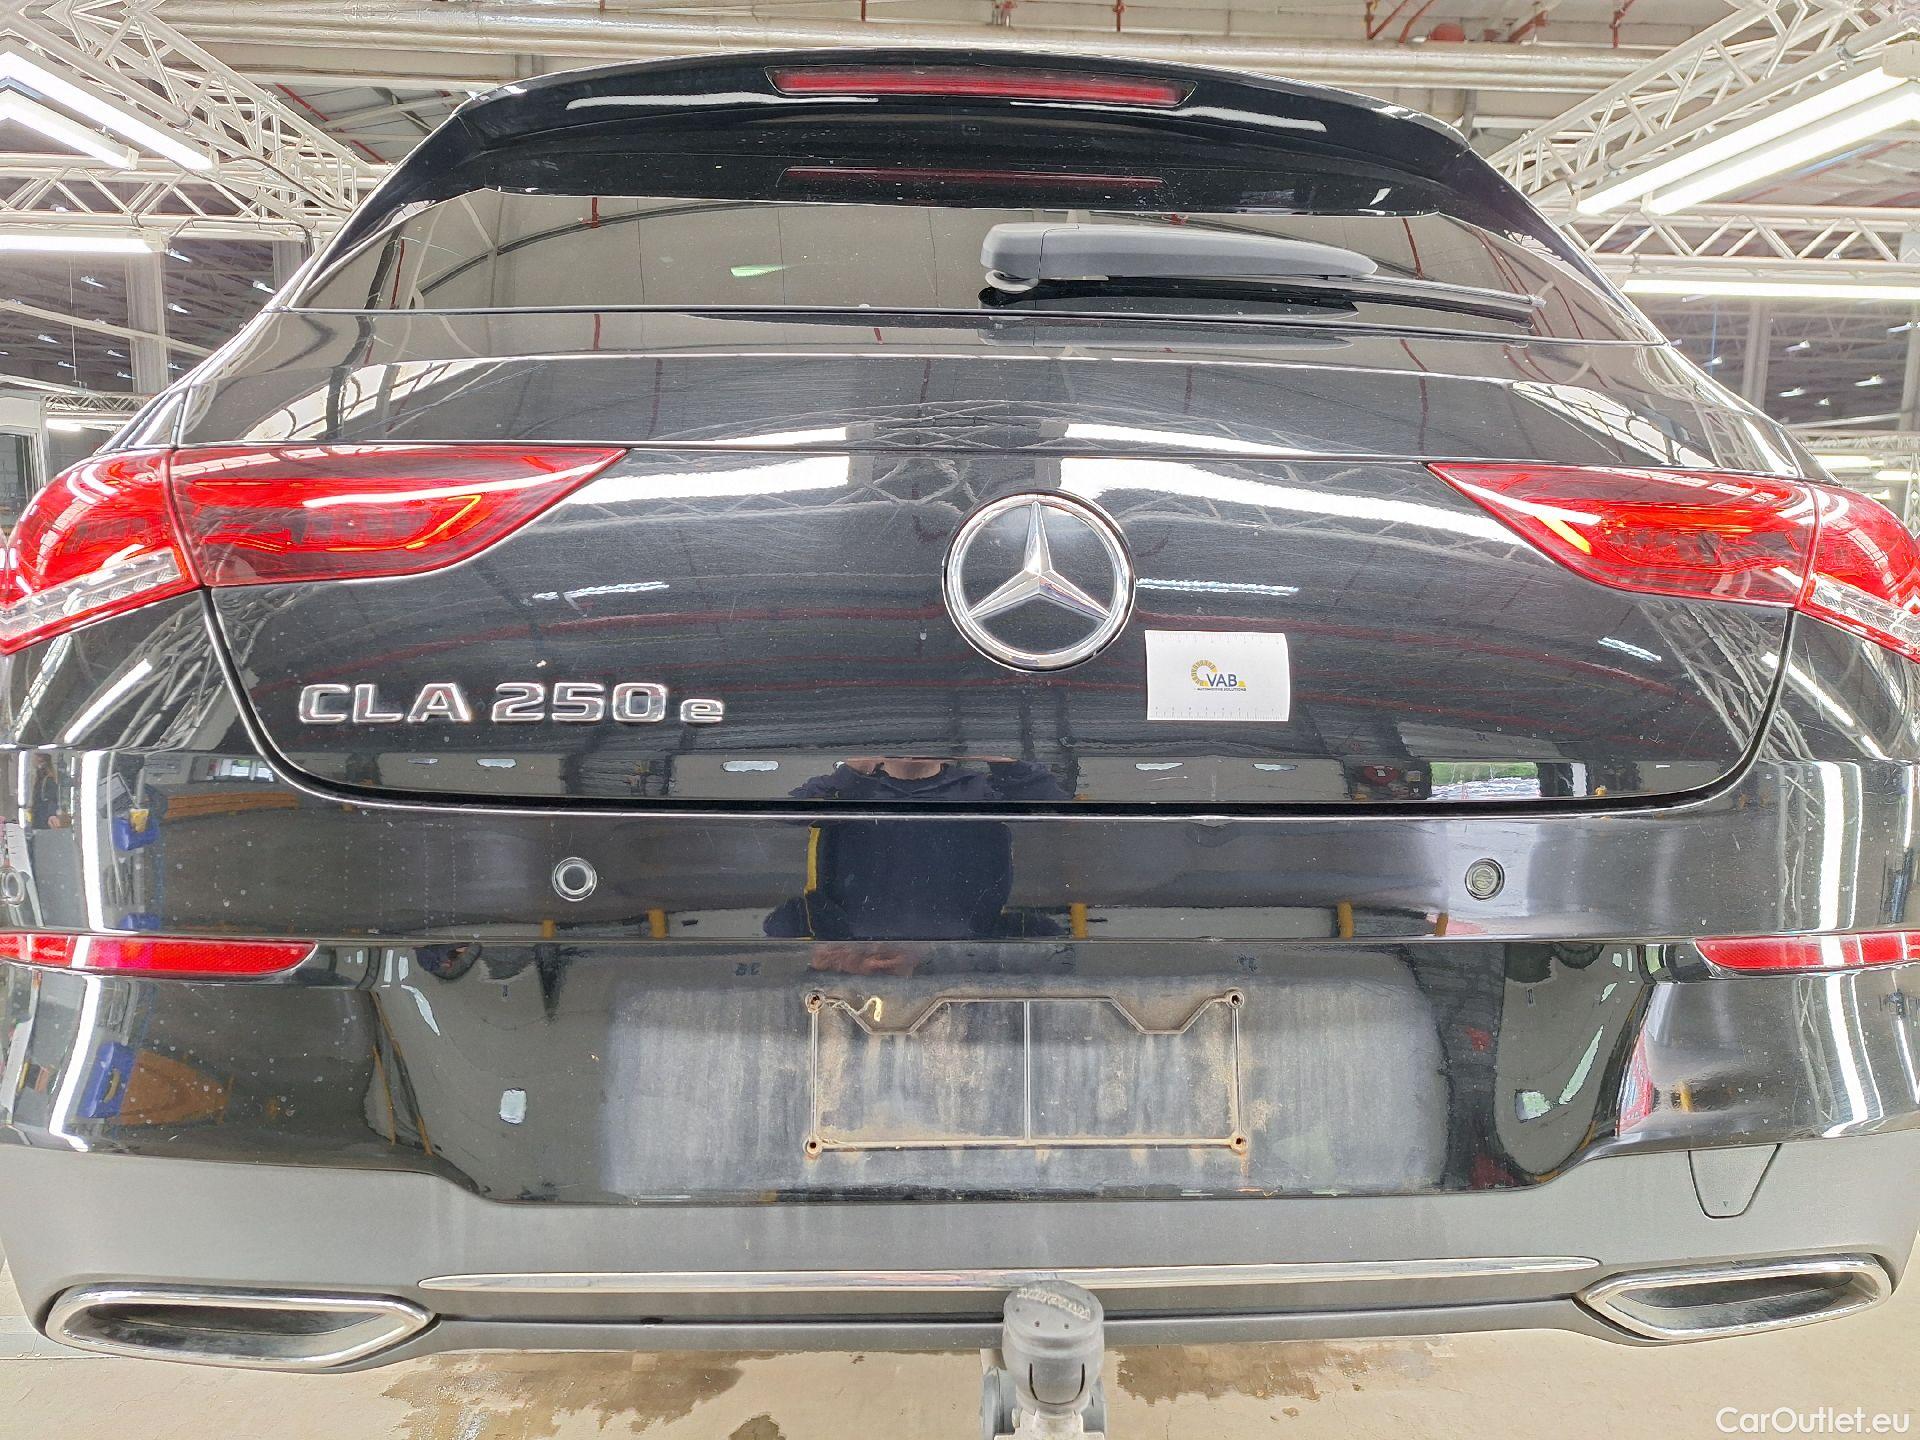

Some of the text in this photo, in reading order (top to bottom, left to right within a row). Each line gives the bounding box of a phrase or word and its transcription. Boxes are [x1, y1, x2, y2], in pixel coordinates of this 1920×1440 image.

[1206, 673, 1238, 687] VAB
[298, 682, 725, 724] CLA 250 e
